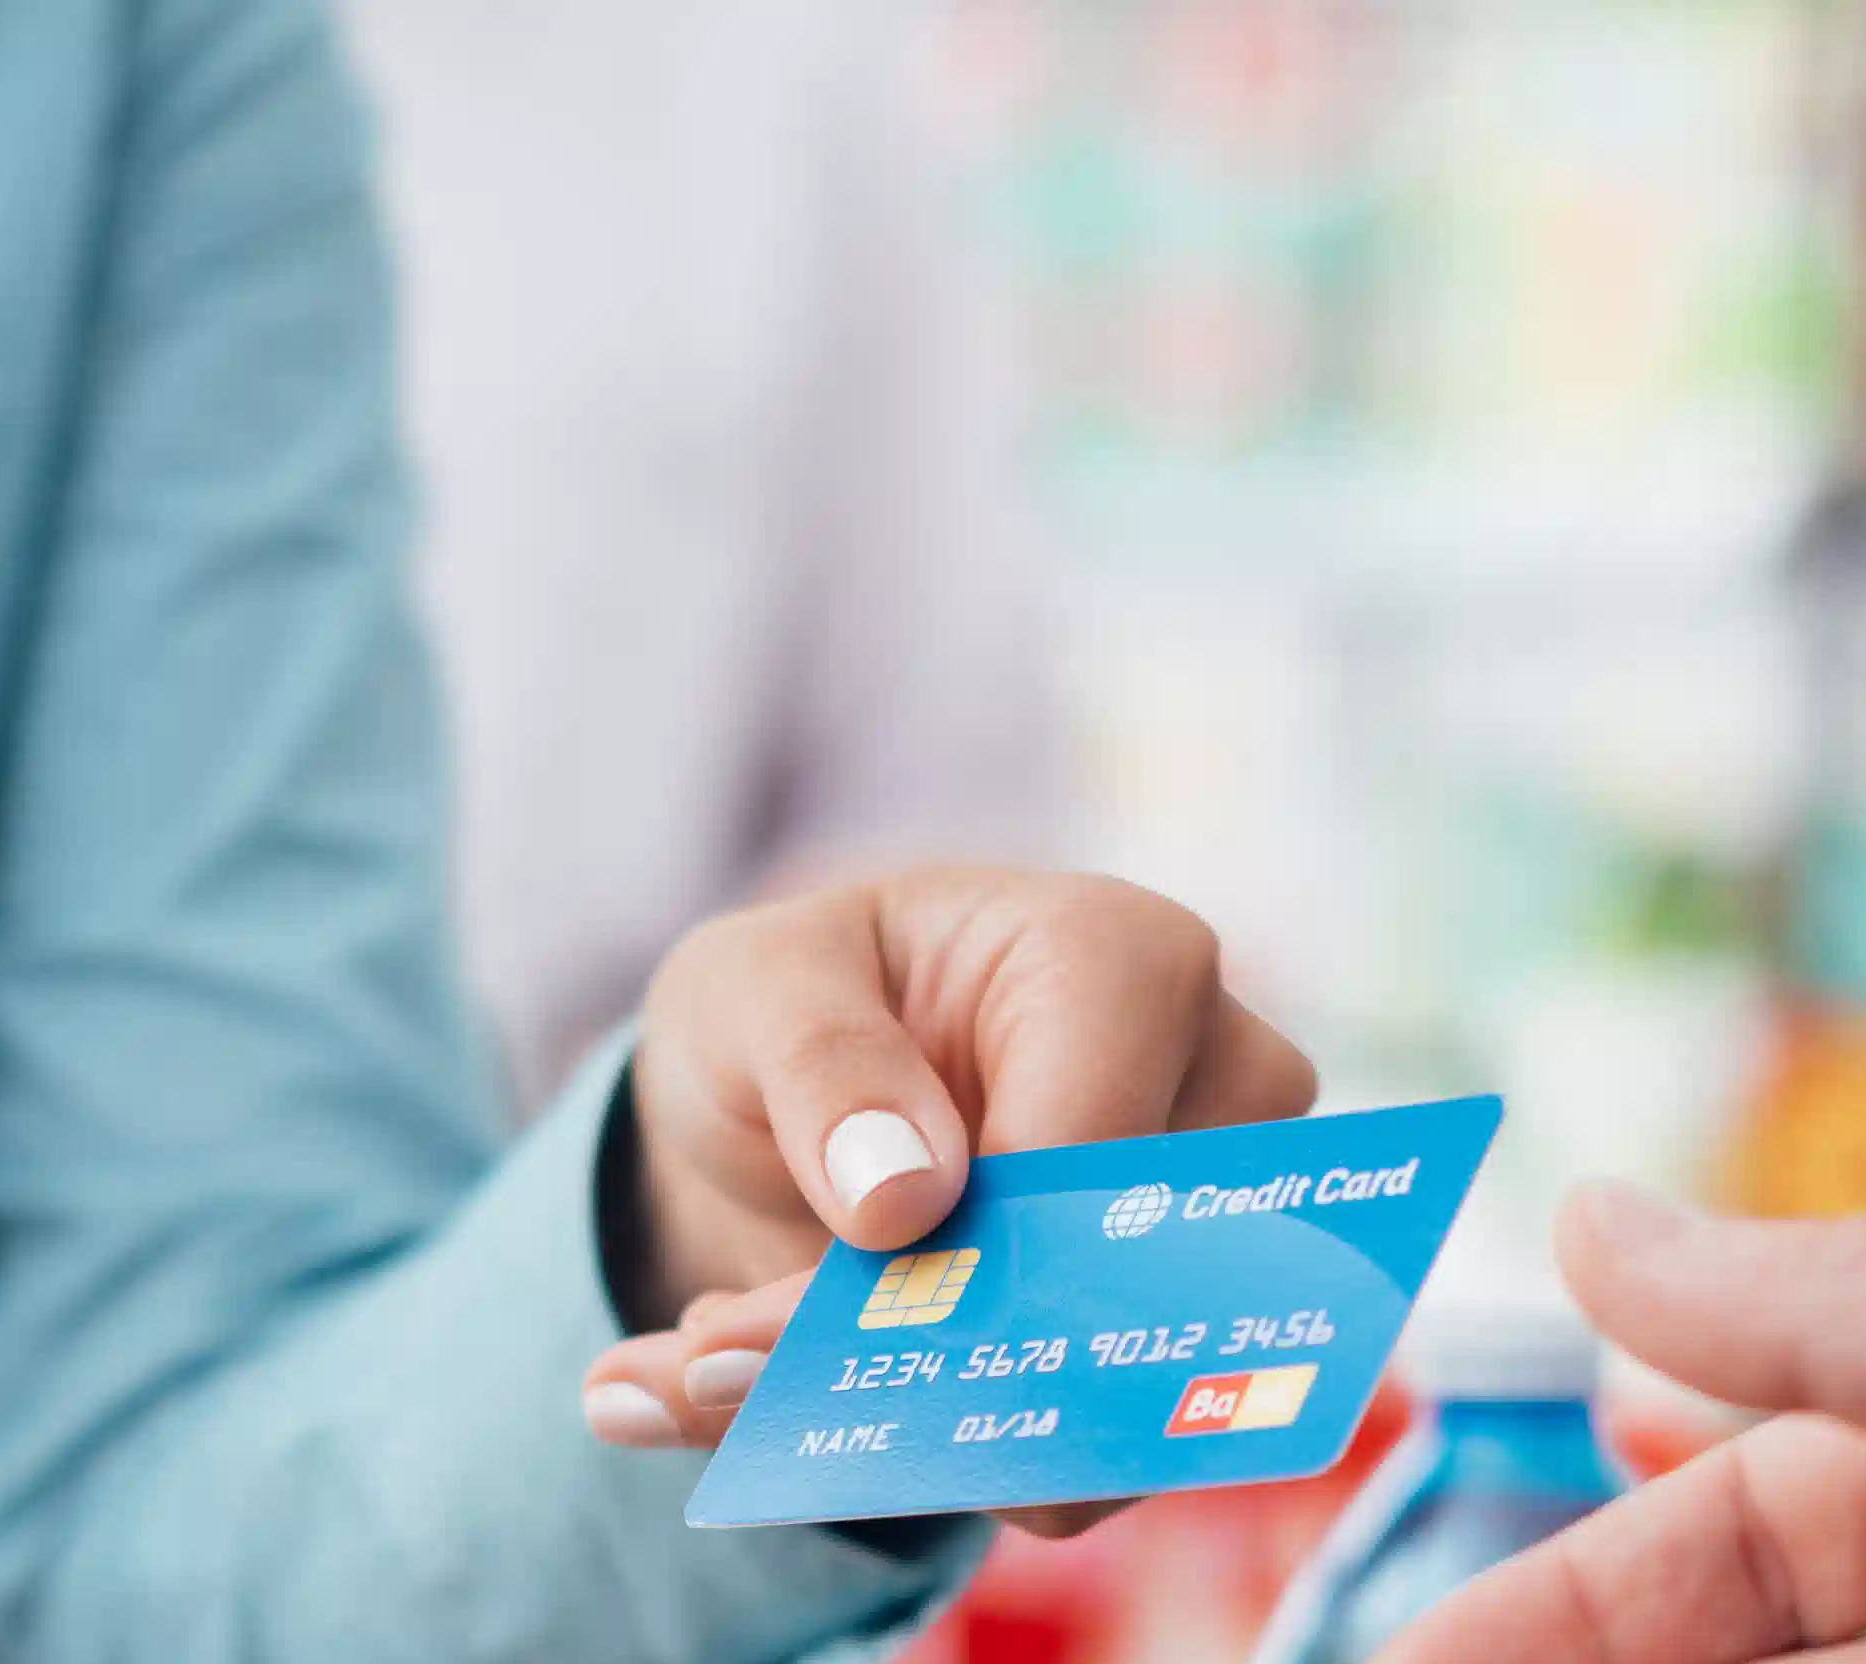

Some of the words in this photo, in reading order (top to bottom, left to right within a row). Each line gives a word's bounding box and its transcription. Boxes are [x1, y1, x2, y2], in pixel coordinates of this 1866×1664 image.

[1182, 1173, 1312, 1221] Credit
[1314, 1157, 1421, 1205] Card
[829, 1351, 946, 1392] 1234
[958, 1337, 1069, 1380] 5678
[1088, 1322, 1208, 1367] 9012
[1218, 1308, 1336, 1355] 3456
[797, 1422, 901, 1457] NAME
